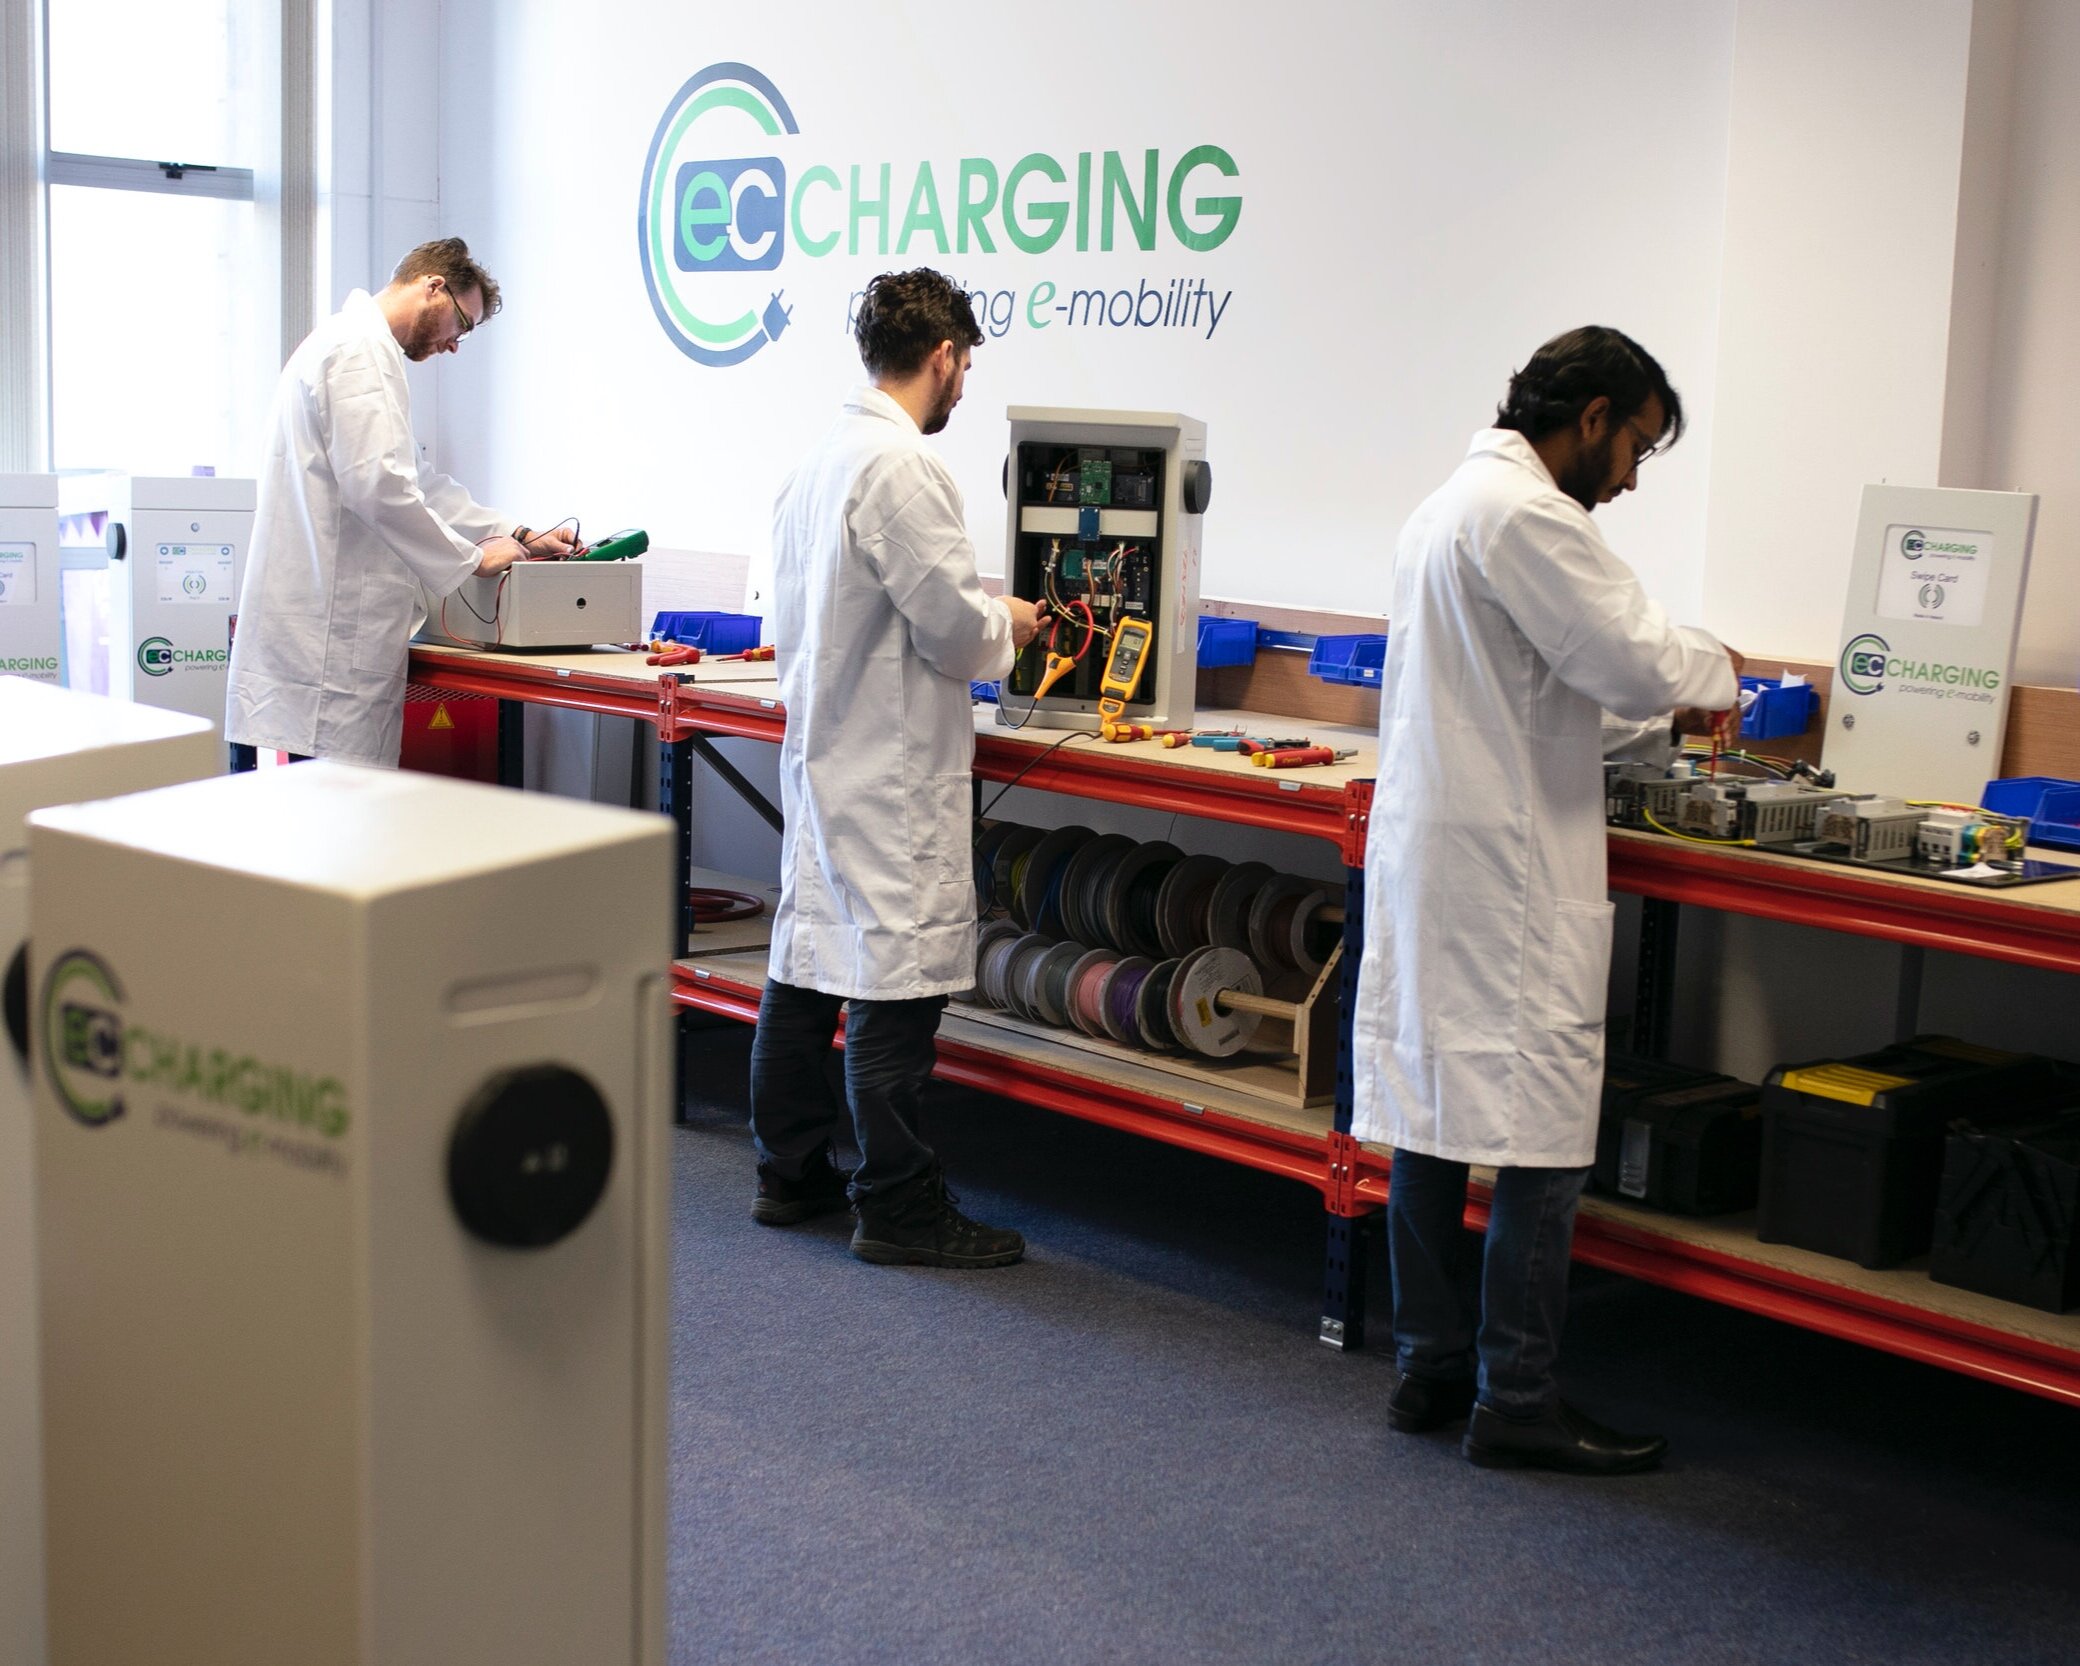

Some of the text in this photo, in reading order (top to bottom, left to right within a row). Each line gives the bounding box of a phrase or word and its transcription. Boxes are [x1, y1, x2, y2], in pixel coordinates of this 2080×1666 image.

[791, 144, 1243, 258] CHARGING
[1026, 278, 1232, 340] e-mobility
[1910, 570, 1959, 583] Swipe Card
[1886, 658, 2000, 689] CHARGING
[1899, 684, 1945, 699] powering
